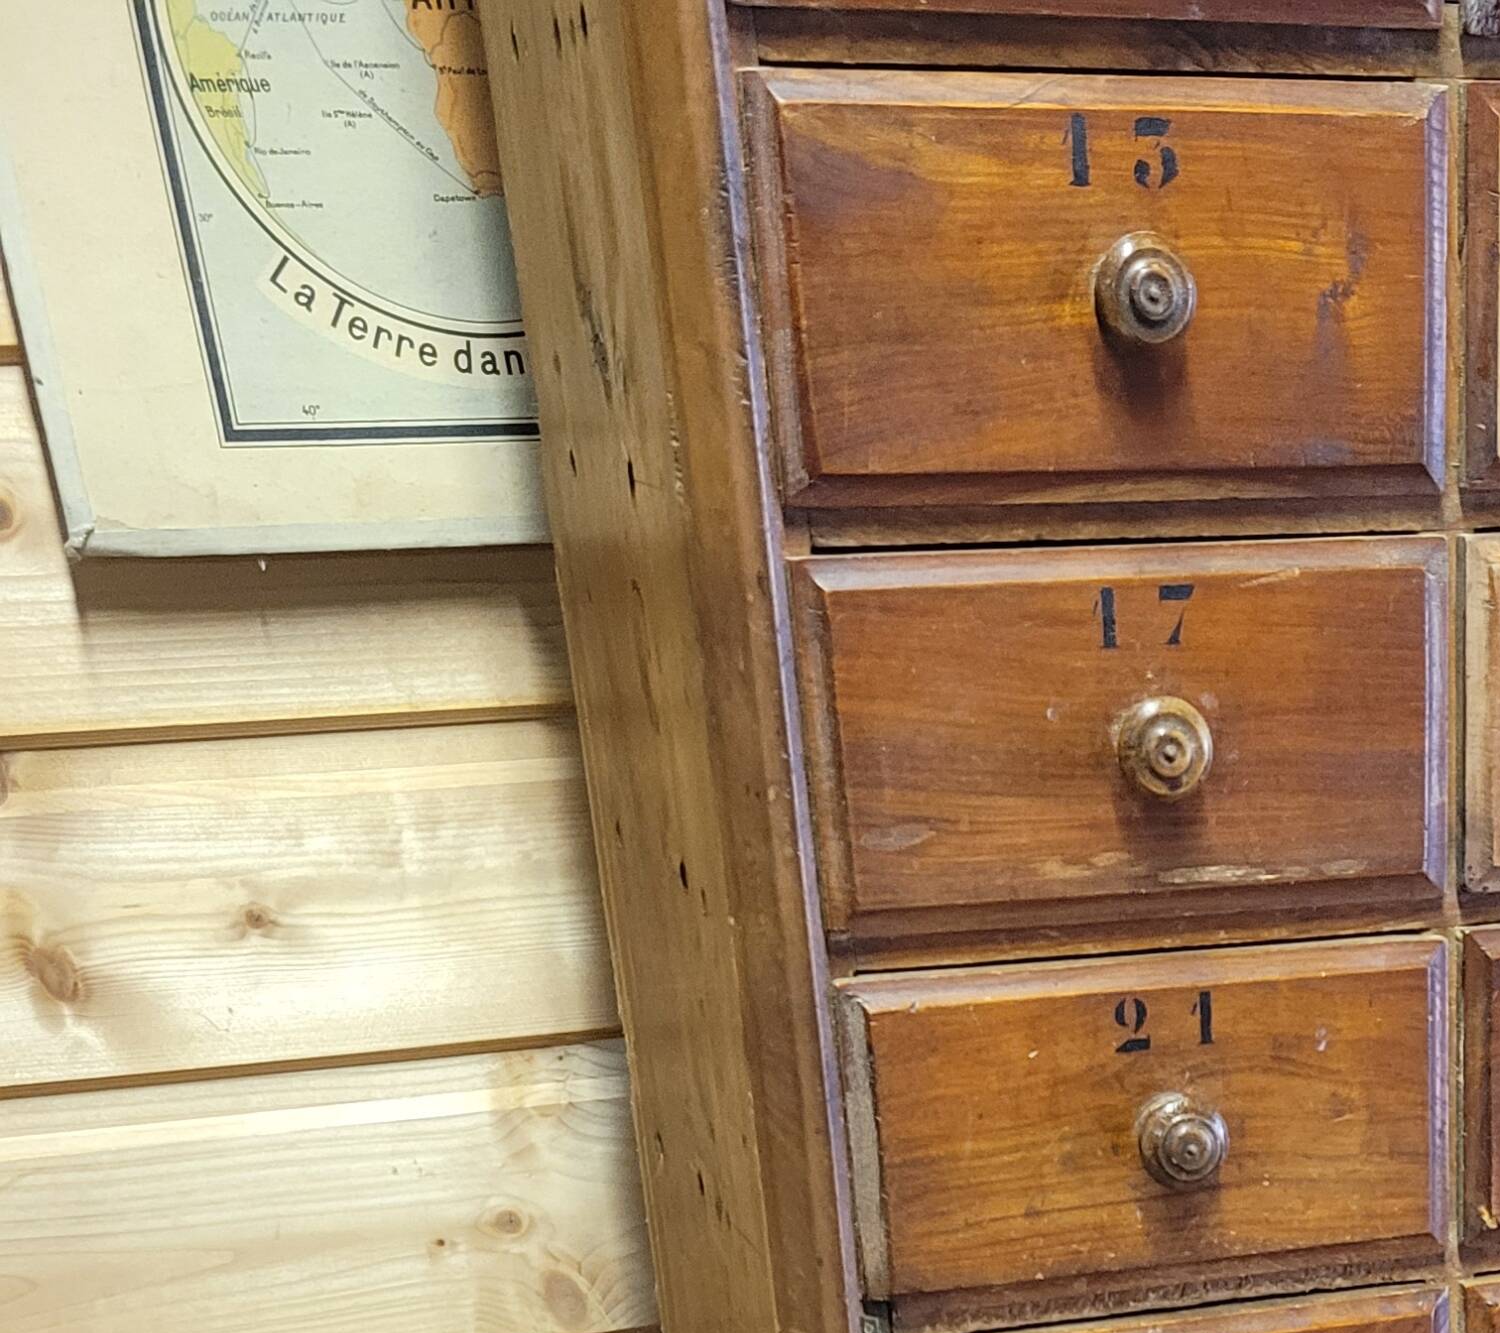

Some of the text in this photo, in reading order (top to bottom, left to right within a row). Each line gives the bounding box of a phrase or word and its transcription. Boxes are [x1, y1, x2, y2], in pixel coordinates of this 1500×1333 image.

[266, 12, 347, 25] ATLANTIQUE
[189, 73, 271, 94] Amérique
[205, 105, 243, 119] Brésil
[270, 255, 316, 312] La
[331, 292, 438, 367] Terre
[1092, 584, 1196, 649] 17
[1114, 990, 1215, 1054] 21
